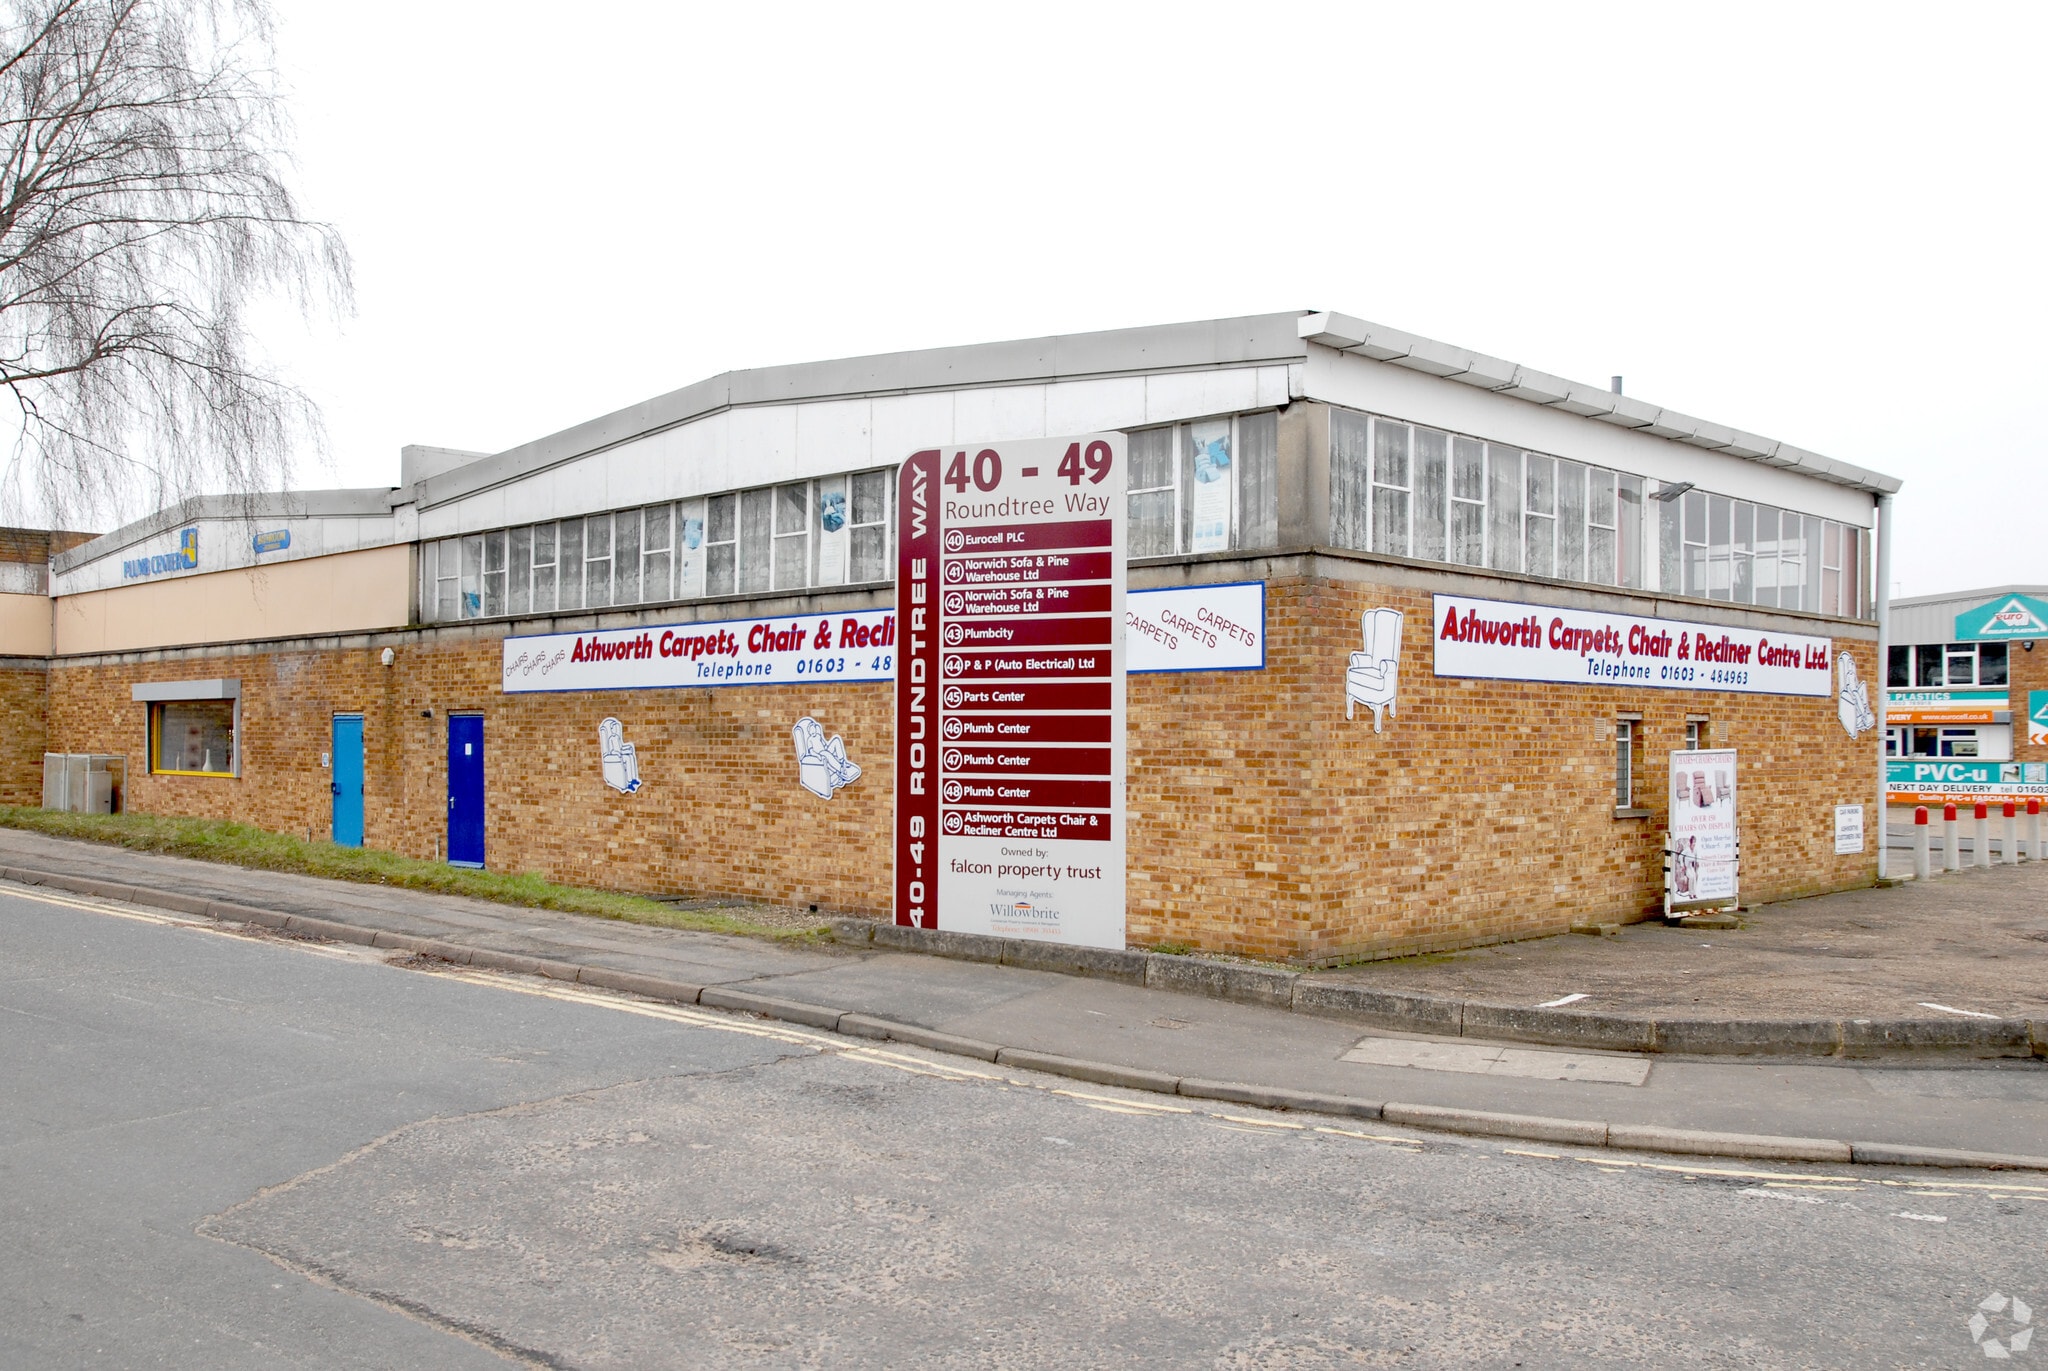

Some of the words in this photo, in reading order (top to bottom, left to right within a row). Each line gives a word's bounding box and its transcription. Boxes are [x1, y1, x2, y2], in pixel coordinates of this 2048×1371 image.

[944, 448, 1002, 494] 40
[1022, 467, 1038, 477] -
[1057, 440, 1113, 486] 49
[912, 462, 927, 540] WAY
[946, 496, 1055, 520] Roundtree
[1065, 492, 1110, 516] Way
[948, 534, 962, 546] 40
[965, 532, 1004, 545] Eurocell
[1006, 532, 1025, 543] PLC
[949, 566, 961, 578] 41
[965, 558, 1008, 570] Norwich
[1010, 557, 1032, 568] Sofa
[1036, 557, 1044, 567] &
[1047, 556, 1070, 566] Pine
[965, 570, 1020, 583] Warehouse
[1023, 570, 1040, 580] Ltd
[948, 597, 962, 609] 42
[965, 590, 1008, 602] Norwich
[1010, 589, 1032, 600] Sofa
[1036, 589, 1044, 599] &
[1047, 588, 1070, 598] Pine
[965, 602, 1020, 614] Warehouse
[1023, 601, 1040, 612] Ltd
[948, 628, 961, 640] 43
[964, 627, 1014, 641] Plumbcity
[1126, 612, 1178, 650] CARPETS
[1161, 610, 1218, 648] CARPETS
[1197, 607, 1256, 647] CARPETS
[570, 630, 653, 663] Ashworth
[659, 628, 740, 662] Carpets,
[747, 621, 806, 653] Chair
[814, 620, 832, 650] &
[1440, 606, 1542, 648] Ashworth
[1549, 617, 1624, 658] Carpets,
[1628, 624, 1672, 658] Chair
[1677, 631, 1690, 660] &
[1694, 632, 1752, 664] Recliner
[1758, 638, 1801, 668] Centre
[1804, 644, 1828, 670] Ltd.
[506, 652, 528, 677] CHAIRS
[522, 650, 546, 676] CHAIRS
[542, 650, 566, 676] CHAIRS
[697, 660, 772, 680] Telephone
[796, 658, 845, 674] 01603
[946, 660, 962, 672] 44
[964, 660, 972, 670] P
[974, 660, 982, 670] &
[985, 660, 992, 670] P
[995, 658, 1023, 671] (Auto
[1026, 657, 1076, 670] Electrical)
[1078, 658, 1095, 669] Ltd
[1588, 658, 1650, 680] Telephone
[1660, 665, 1694, 682] 01603
[1710, 669, 1748, 684] 484963
[911, 557, 927, 795] ROUNDTREE
[946, 692, 960, 704] 45
[964, 692, 990, 702] Parts
[992, 691, 1025, 702] Center
[1895, 692, 1951, 700] PLASTICS
[946, 722, 960, 734] 46
[964, 723, 994, 734] Plumb
[998, 723, 1030, 734] Center
[946, 754, 960, 766] 47
[964, 754, 994, 766] Plumb
[998, 755, 1030, 766] Center
[1914, 764, 1988, 782] PVC-u
[946, 786, 960, 797] 48
[964, 786, 994, 797] Plumb
[998, 787, 1030, 798] Center
[1919, 784, 1939, 792] DAY
[946, 817, 961, 828] 49
[964, 812, 1014, 824] Ashworth
[1017, 813, 1057, 828] Carpets
[1060, 814, 1086, 826] Chair
[1090, 816, 1098, 826] &
[1675, 824, 1696, 832] CHAIRS
[1708, 822, 1731, 830] DISPLAY
[964, 825, 1002, 837] Recliner
[1005, 826, 1038, 838] Centre
[1041, 826, 1057, 838] Ltd
[1001, 847, 1032, 858] Owned
[1035, 848, 1049, 860] by:
[910, 816, 925, 929] 40-49
[950, 858, 992, 874] falcon
[998, 863, 1062, 881] property
[1066, 864, 1102, 879] trust
[996, 889, 1028, 898] Managing
[990, 904, 1060, 920] Willowbrite
